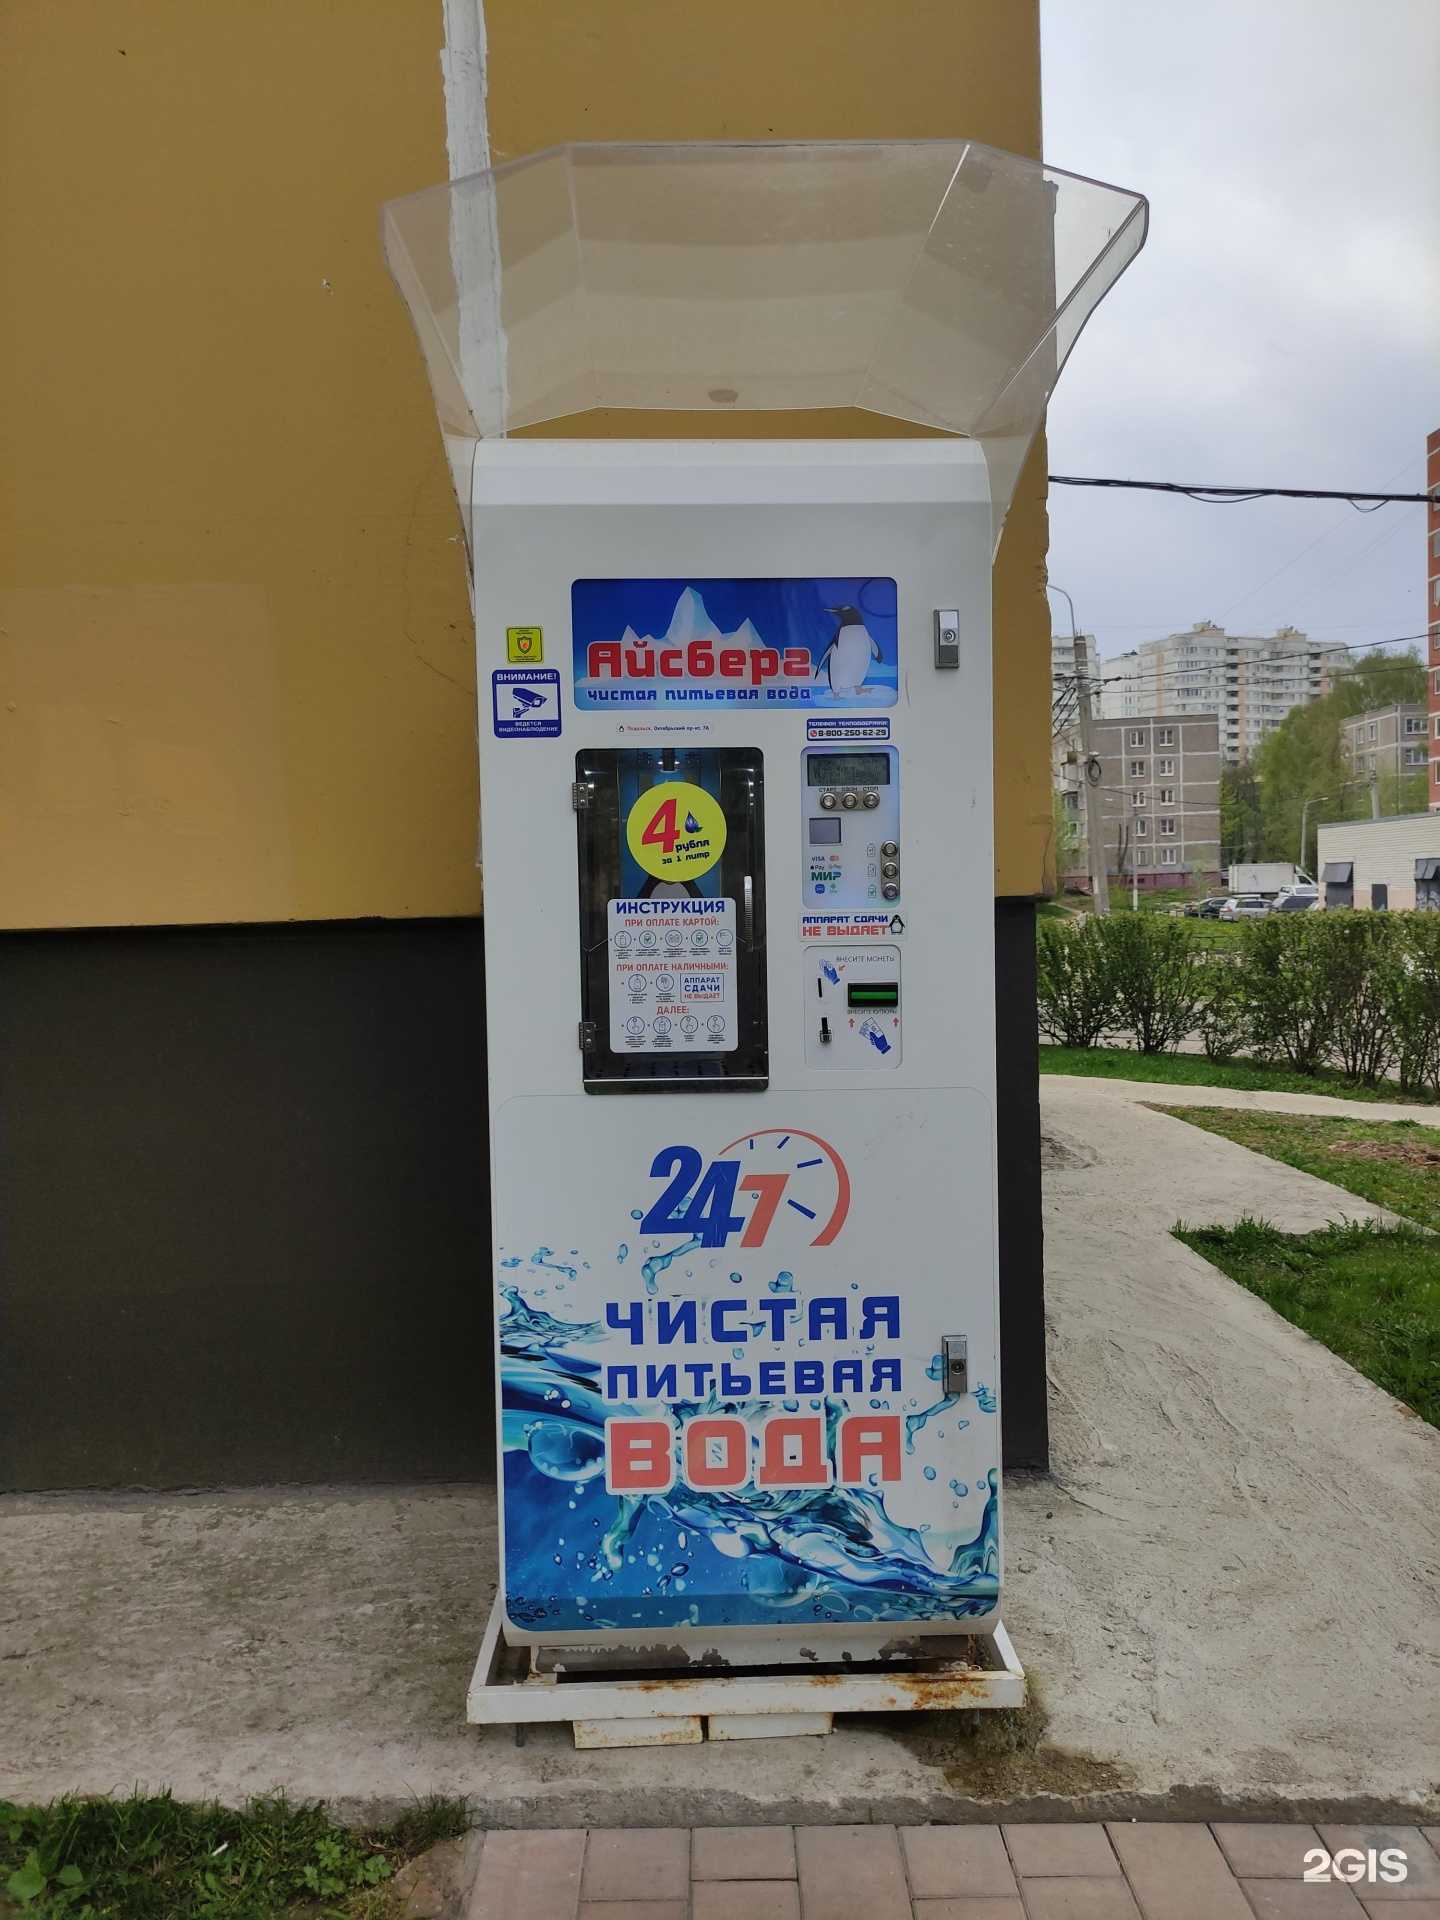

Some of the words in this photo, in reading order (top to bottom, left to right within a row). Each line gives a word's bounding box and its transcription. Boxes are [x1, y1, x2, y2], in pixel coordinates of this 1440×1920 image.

[588, 640, 811, 686] Айсберг
[496, 673, 557, 681] ВНИМАНИЕ!
[587, 688, 657, 702] чистая
[665, 687, 759, 702] питьевая
[766, 687, 811, 701] вода
[818, 729, 887, 737] 8-800-250-62-29
[641, 799, 681, 854] 4
[675, 839, 710, 853] рубля
[661, 857, 673, 865] за
[676, 855, 682, 863] 1
[685, 851, 710, 861] литр
[811, 871, 842, 881] МИР
[616, 900, 725, 915] ИНСТРУКЦИЯ
[624, 918, 642, 927] ПРИ
[645, 917, 680, 927] ОПЛАТЕ
[682, 916, 720, 926] КАРТОЙ:
[802, 916, 850, 924] АППАРАТ
[853, 915, 889, 923] СДАЧИ
[802, 926, 821, 937] НЕ
[827, 925, 888, 936] ВЫДАЕТ
[616, 963, 634, 972] ПРИ
[636, 963, 669, 972] ОПЛАТЕ
[671, 962, 729, 971] НАЛИЧНЫМИ:
[684, 976, 721, 984] АППАРАТ
[684, 984, 720, 993] СДАЧИ
[656, 1006, 690, 1016] ДАЛЕЕ:
[606, 1296, 900, 1345] ЧИСТАЯ
[607, 1359, 902, 1399] ПИТЬЕВАЯ
[610, 1415, 902, 1489] ВОДА
